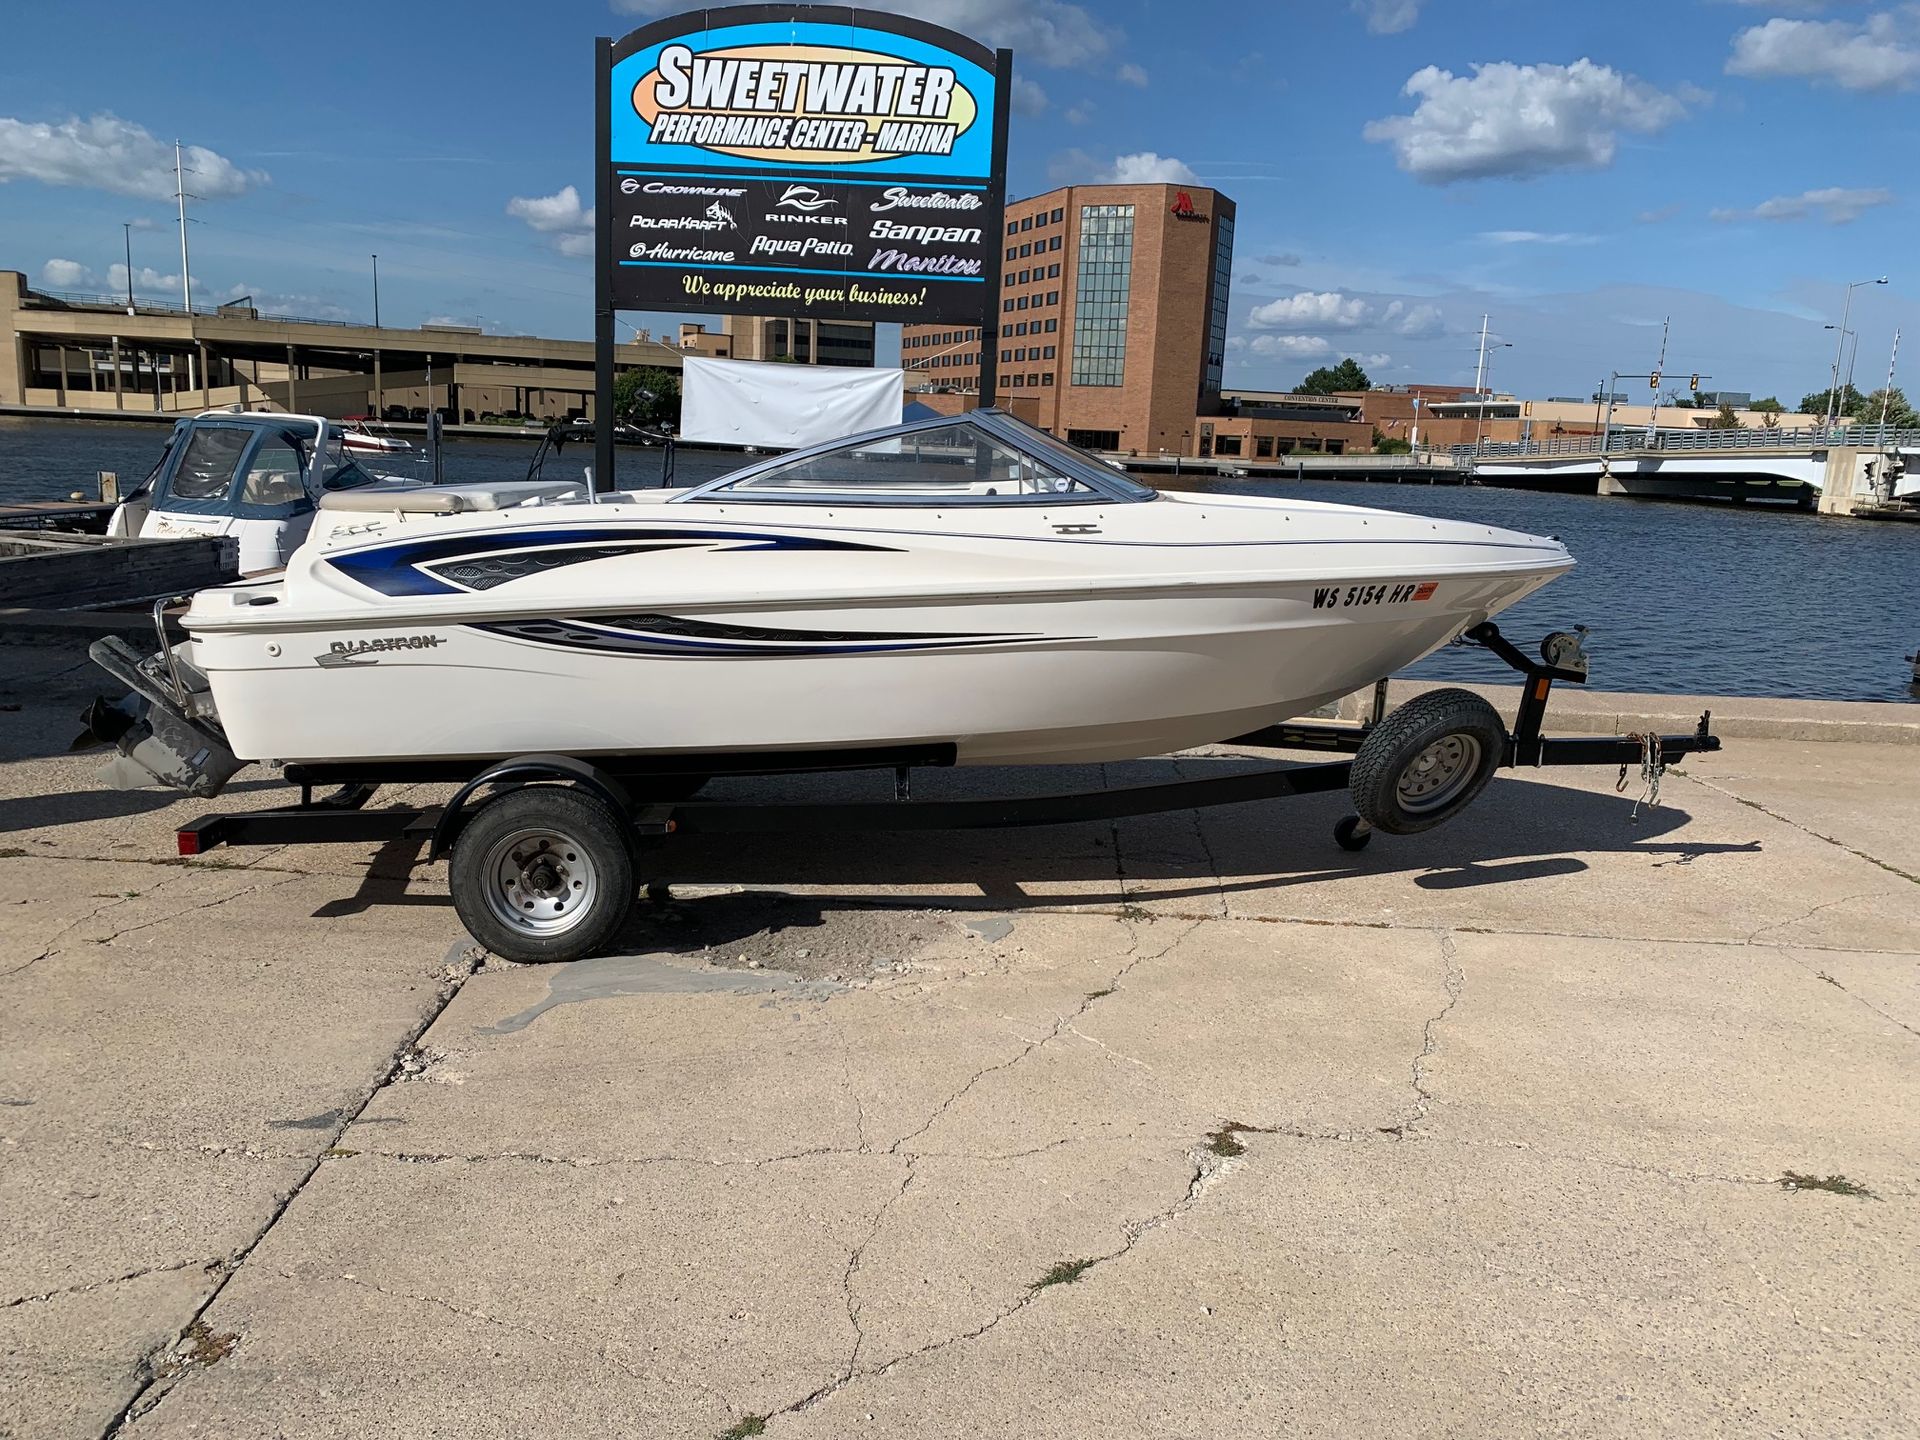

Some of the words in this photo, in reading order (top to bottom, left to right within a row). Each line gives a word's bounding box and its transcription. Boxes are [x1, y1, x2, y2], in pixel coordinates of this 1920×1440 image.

[655, 45, 954, 117] SWEETWATER
[650, 113, 794, 147] PERFORMANCE
[790, 118, 867, 151] CENTER
[874, 122, 957, 154] MARINA
[643, 182, 748, 197] CROWNLINE
[870, 187, 983, 212] Sweetwater
[765, 213, 848, 225] RINKER
[869, 220, 981, 244] Sanpan
[646, 241, 736, 262] Hurricane
[867, 248, 981, 275] Manitou
[682, 275, 711, 295] We
[713, 281, 801, 301] appreciate
[804, 287, 845, 306] your
[849, 283, 927, 306] business!
[1318, 396, 1339, 404] CENTER
[1312, 587, 1340, 609] WS
[1343, 585, 1388, 607] 5154
[1388, 584, 1416, 603] HR
